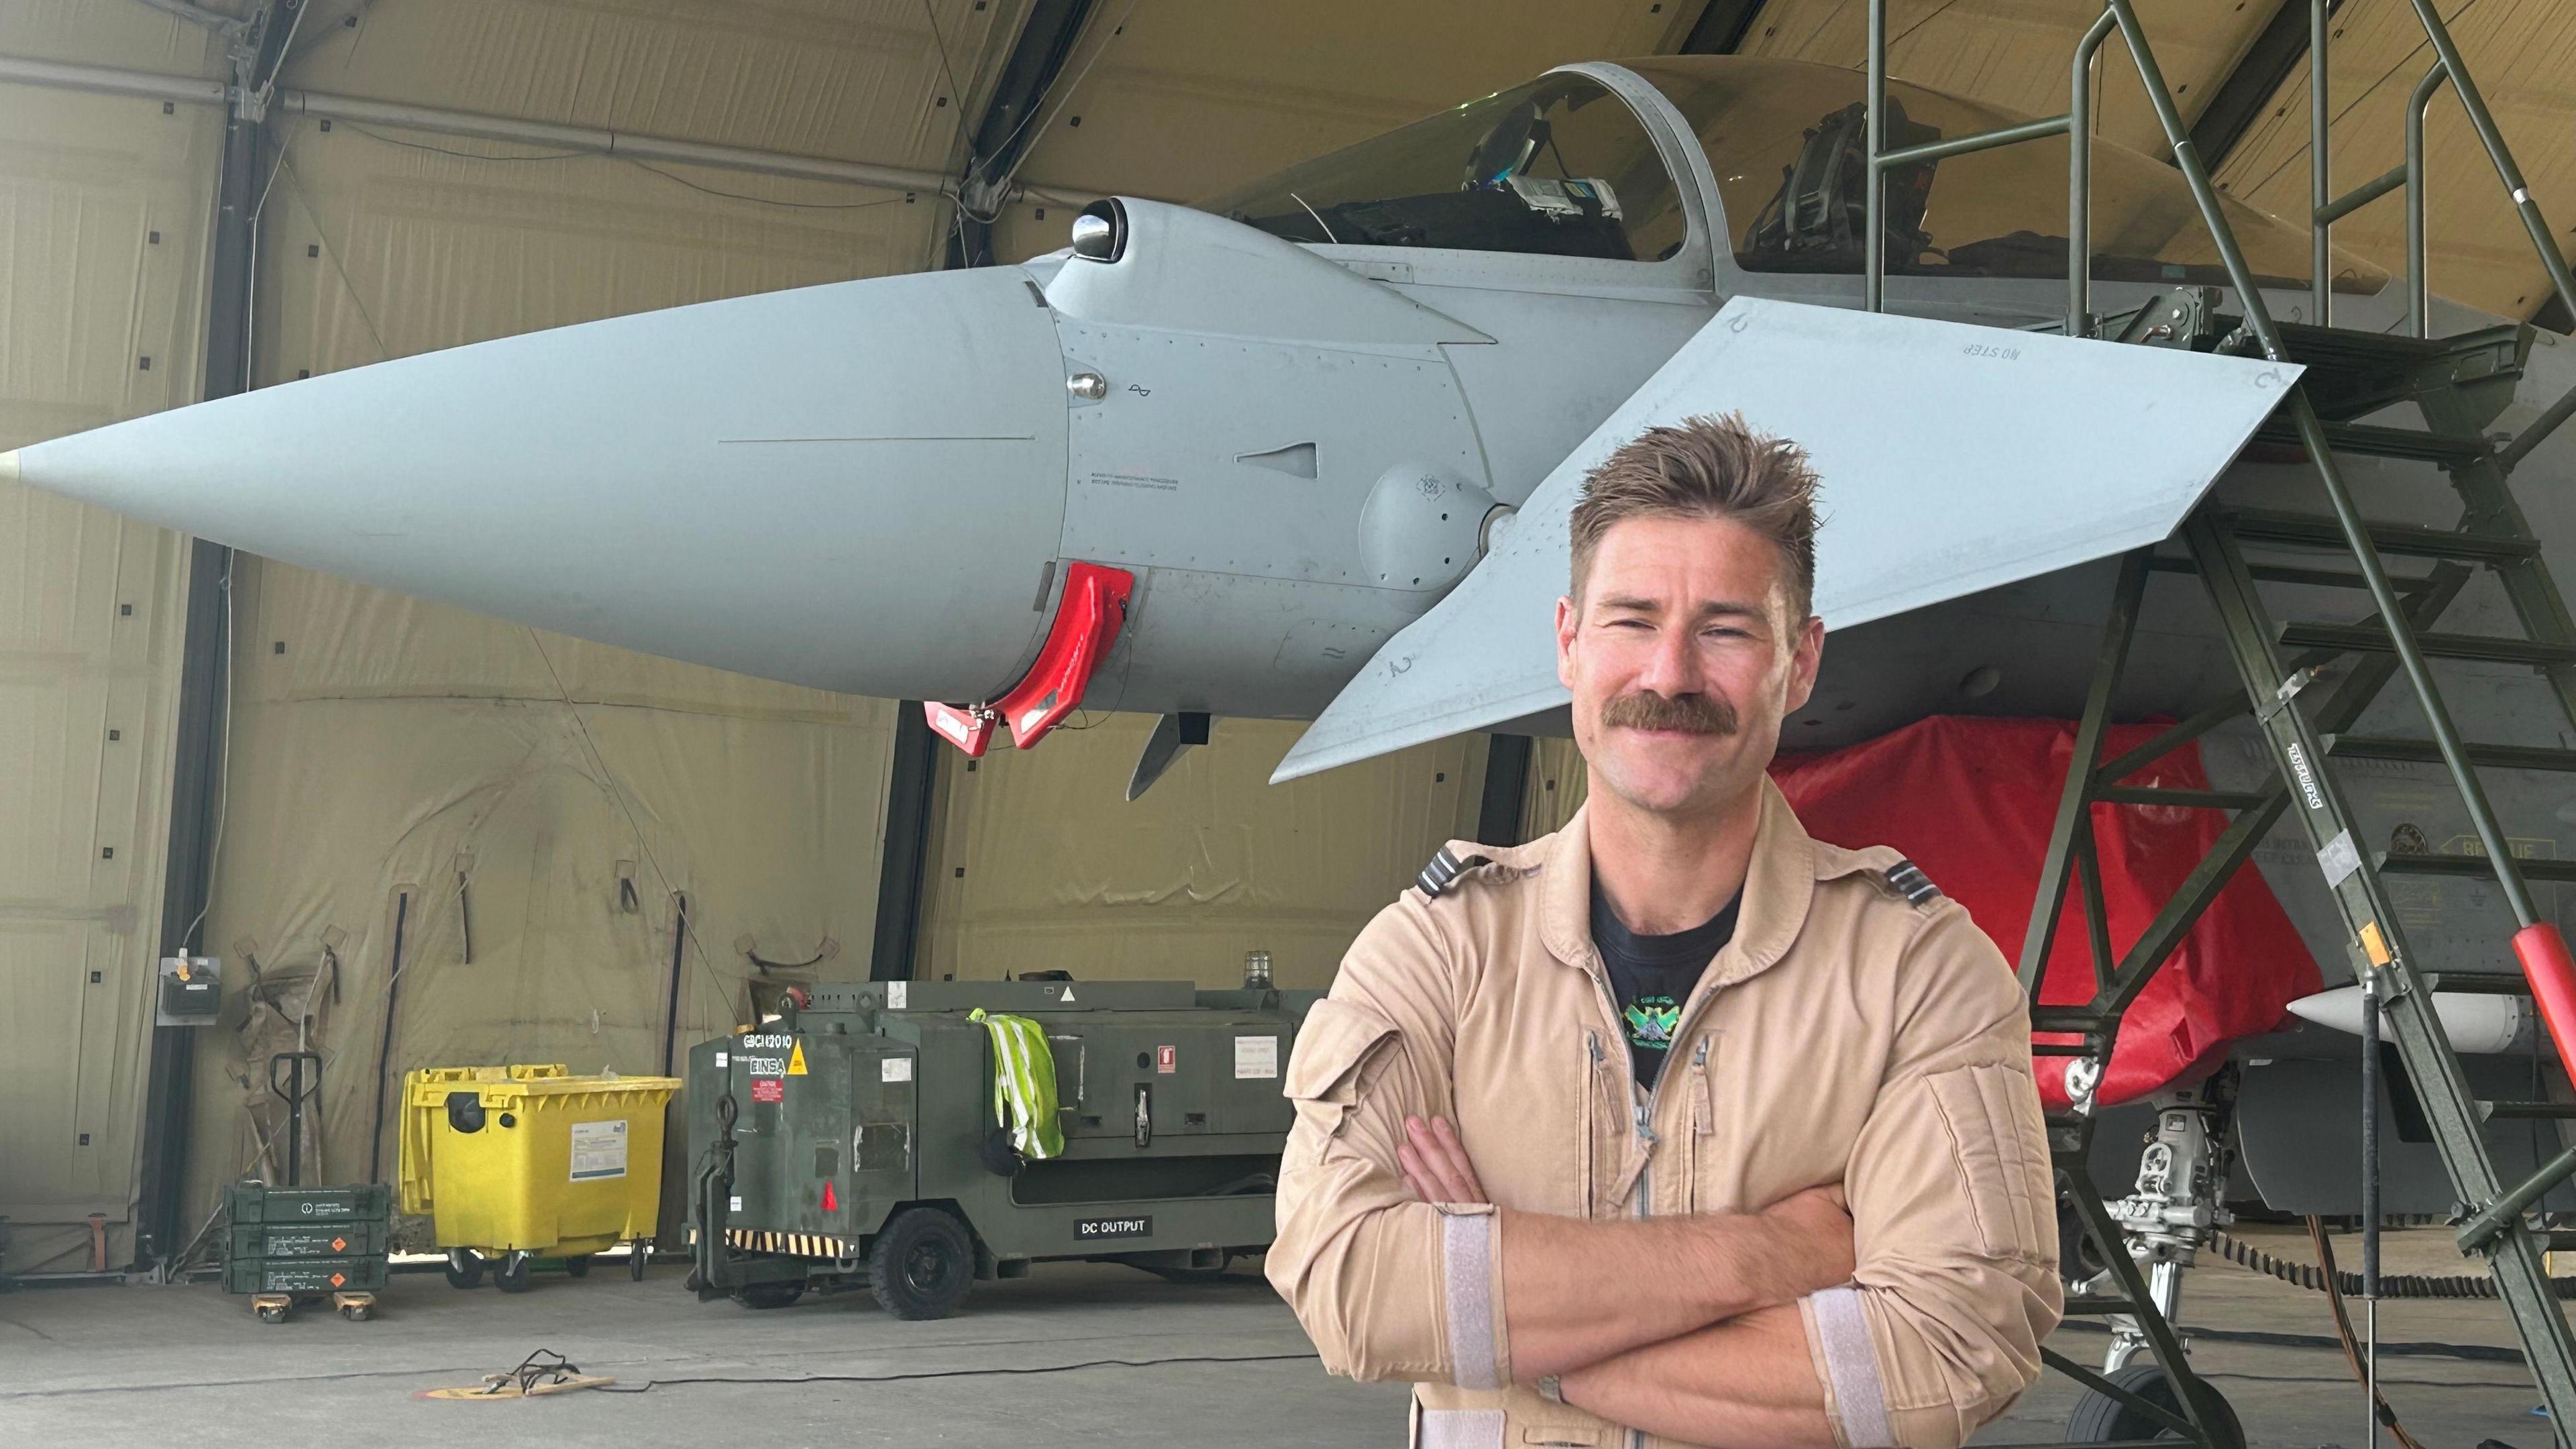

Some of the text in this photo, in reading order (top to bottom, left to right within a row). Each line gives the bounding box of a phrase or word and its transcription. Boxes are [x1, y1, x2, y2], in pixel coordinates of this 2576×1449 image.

[1963, 343, 2021, 360] NO STEP
[1081, 1220, 1145, 1234] DC OUTPUT
